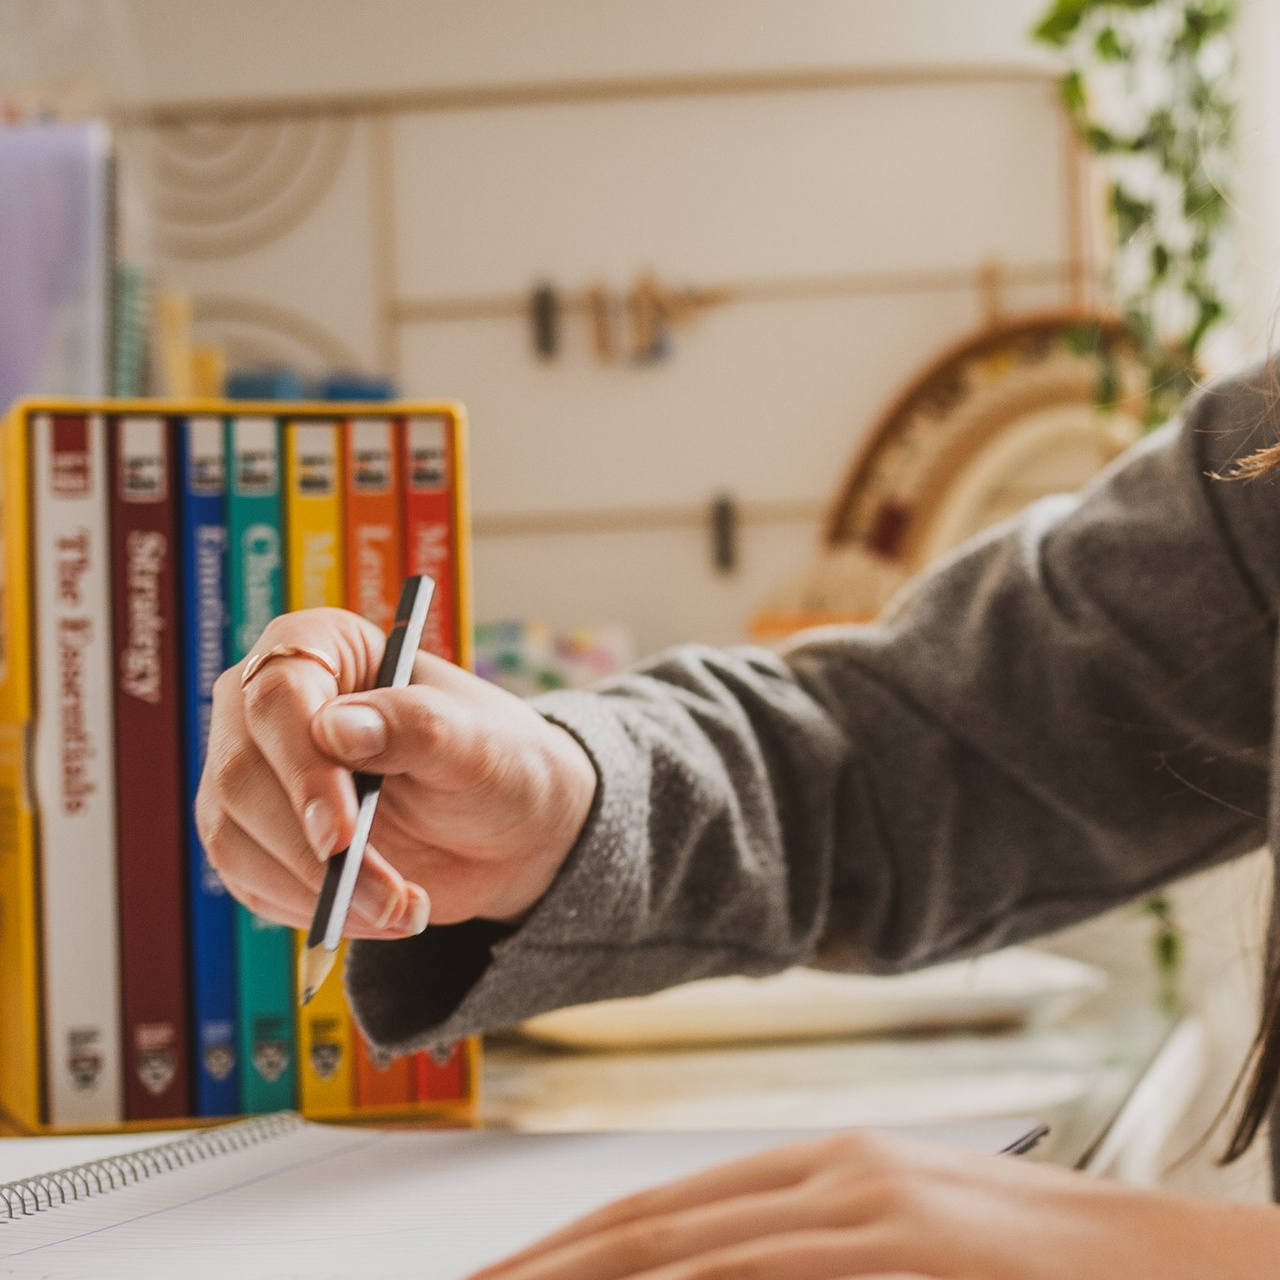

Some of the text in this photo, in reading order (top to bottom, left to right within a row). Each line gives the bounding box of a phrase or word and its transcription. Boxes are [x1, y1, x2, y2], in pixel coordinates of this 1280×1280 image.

[57, 528, 89, 606] The
[121, 531, 166, 703] Strategy
[59, 620, 96, 813] Essentials
